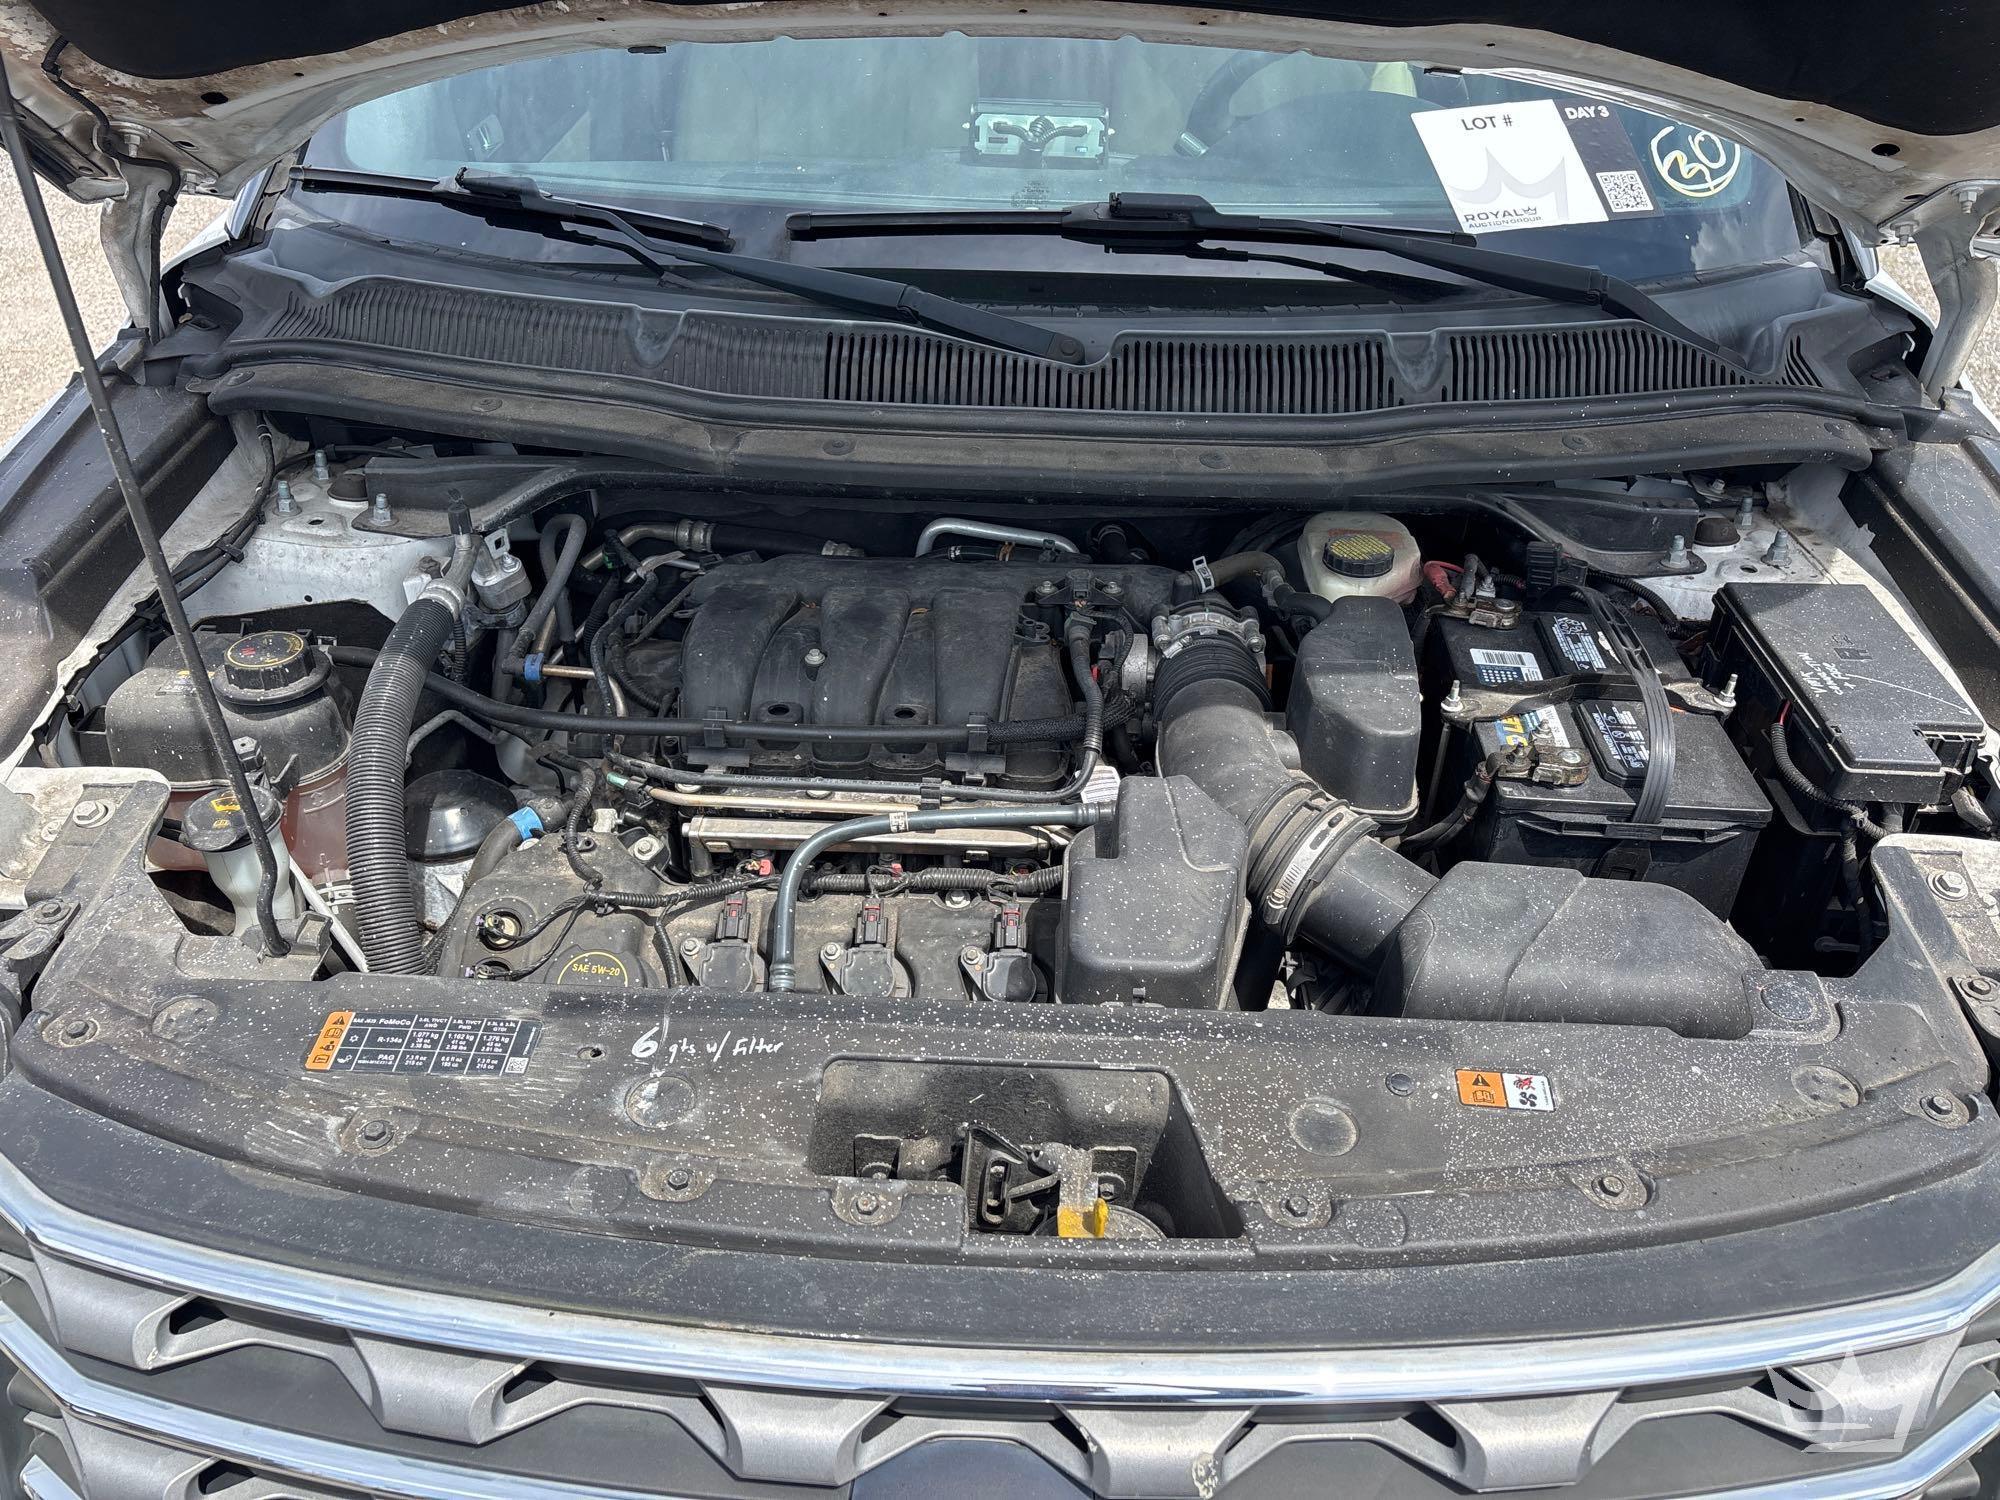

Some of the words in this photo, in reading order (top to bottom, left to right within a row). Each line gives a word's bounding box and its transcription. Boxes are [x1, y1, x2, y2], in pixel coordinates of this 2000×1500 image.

[1564, 106, 1596, 120] DAY
[1597, 105, 1609, 118] 3
[1461, 116, 1496, 131] LOT
[1504, 114, 1512, 127] #
[1464, 208, 1524, 222] ROYAL
[572, 963, 590, 973] SAE
[591, 965, 620, 976] 5W-20
[632, 1026, 660, 1058] 6
